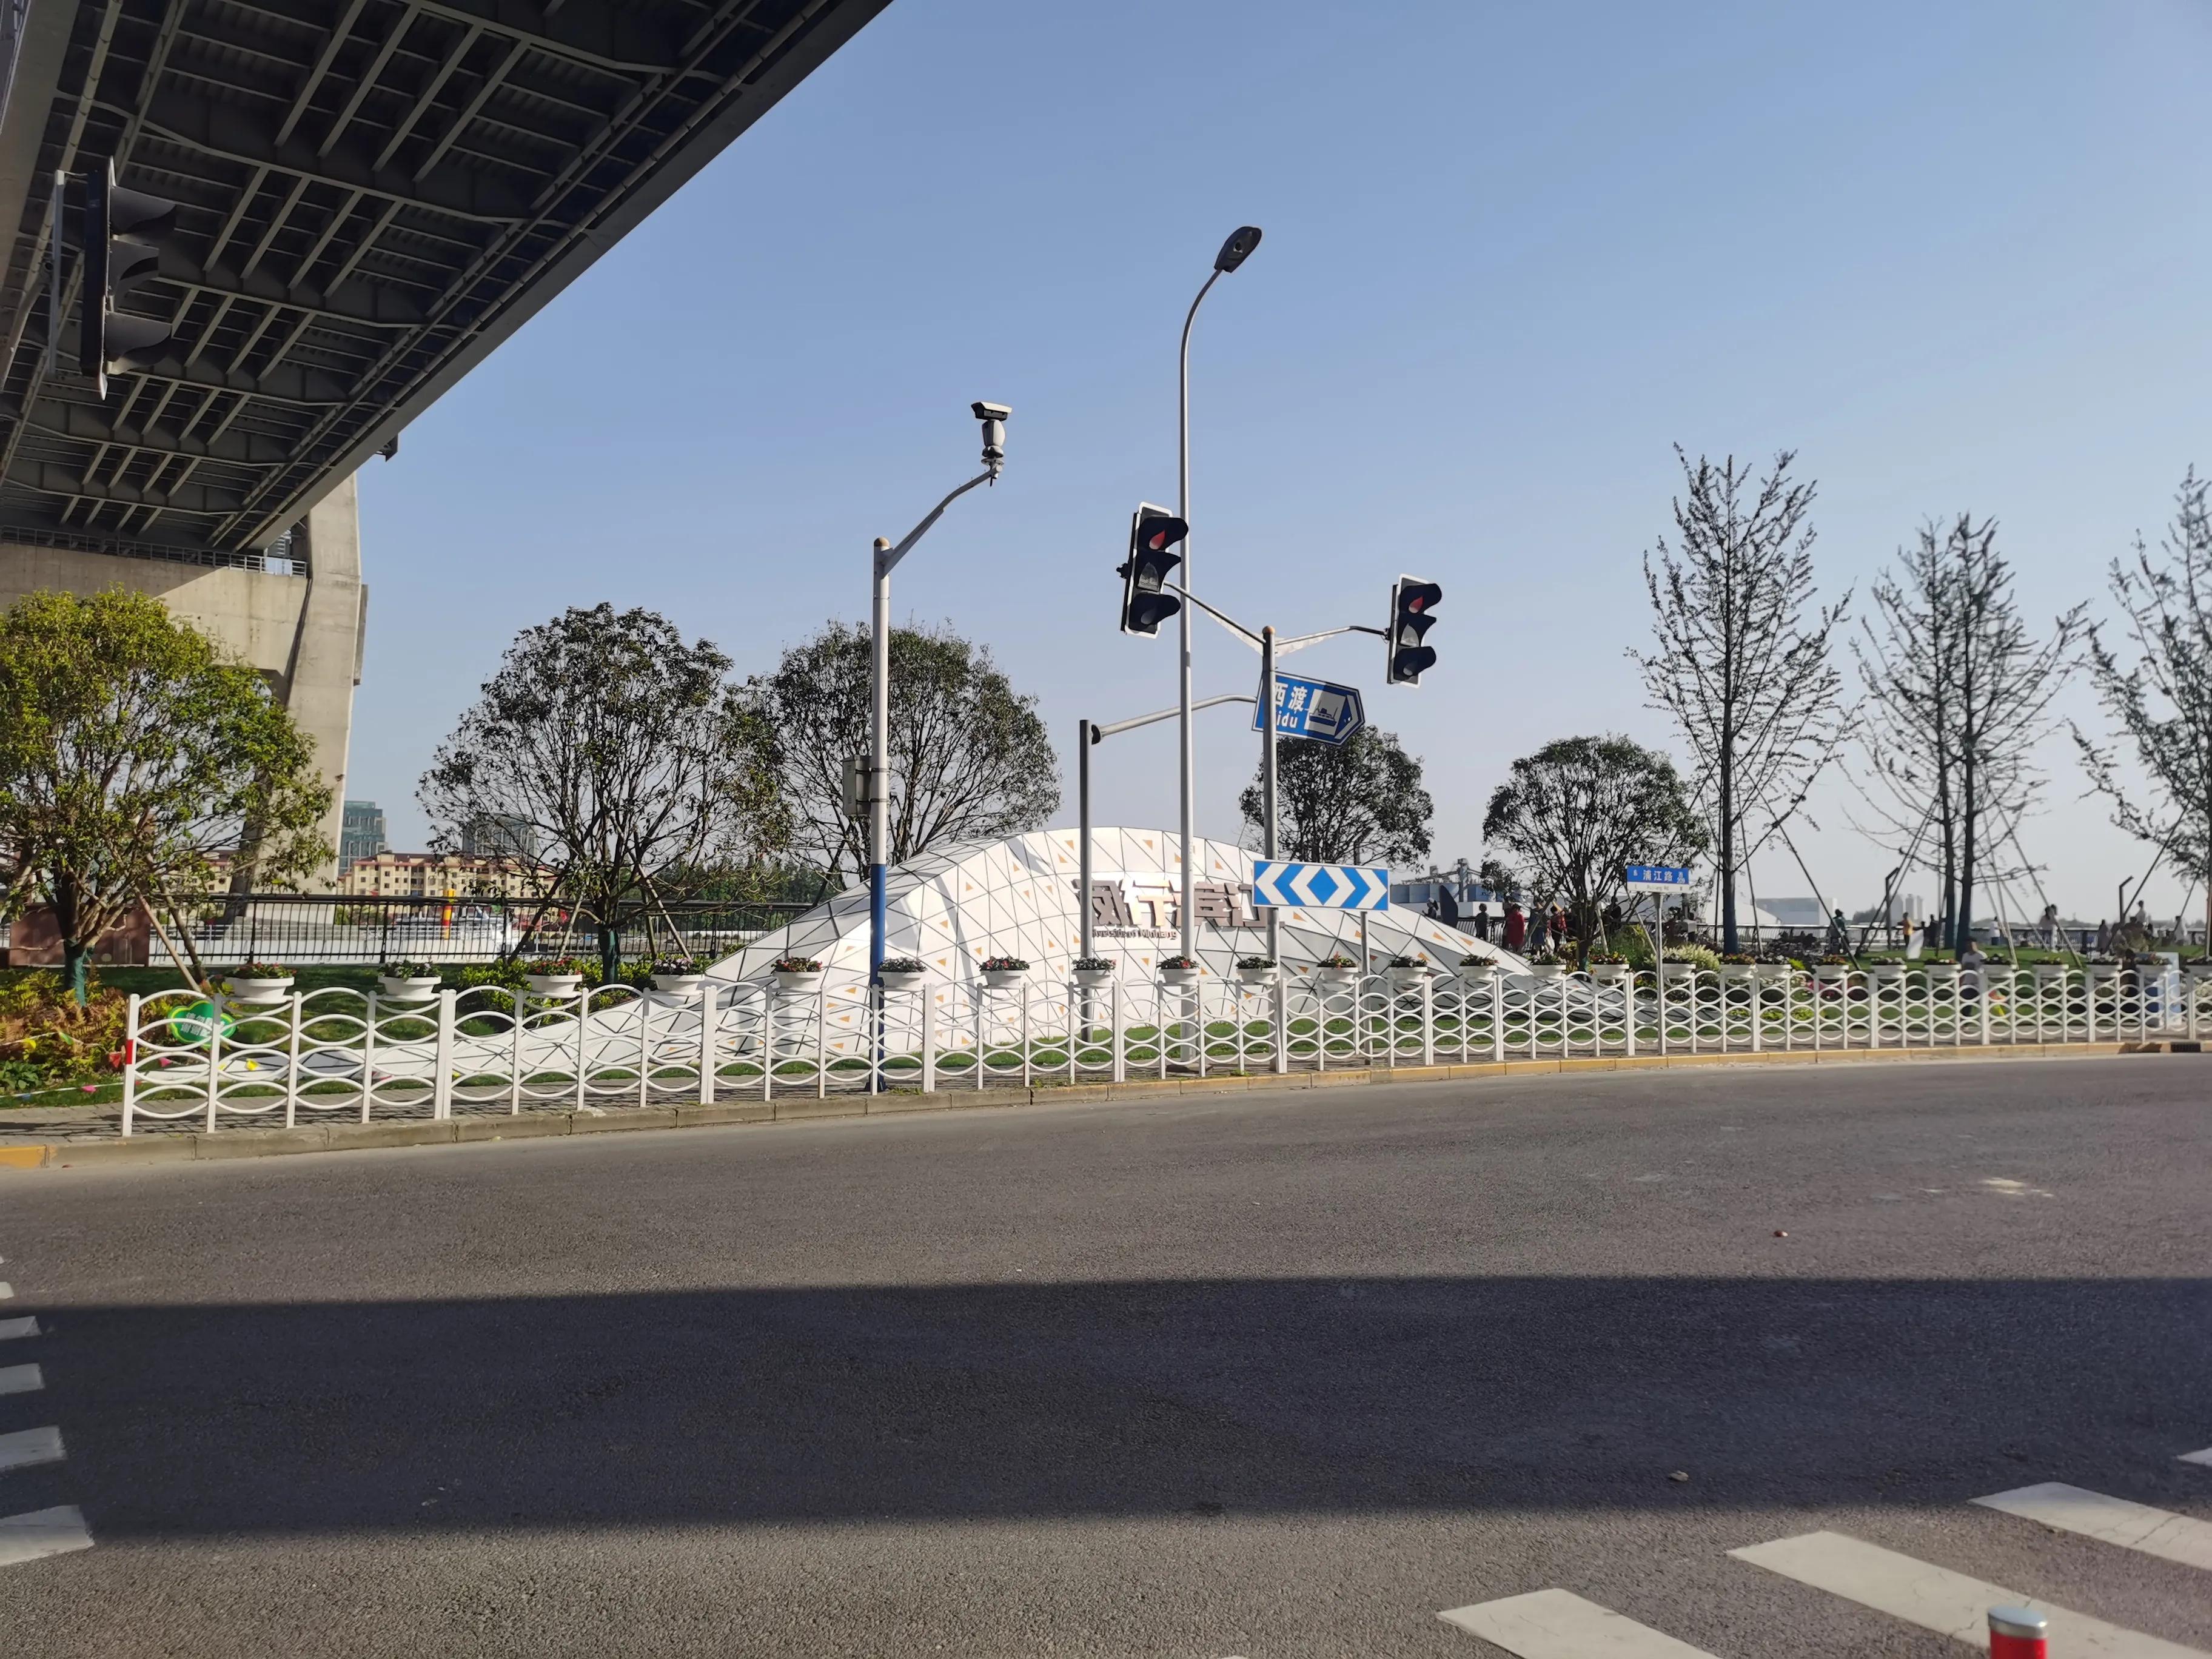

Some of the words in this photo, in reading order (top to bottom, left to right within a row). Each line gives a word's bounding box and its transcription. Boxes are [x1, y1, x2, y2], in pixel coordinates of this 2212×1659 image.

[1275, 710, 1298, 728] idu
[1643, 869, 1673, 882] 浦江路
[1092, 929, 1127, 938] iverside
[1139, 928, 1178, 940] Minhang
